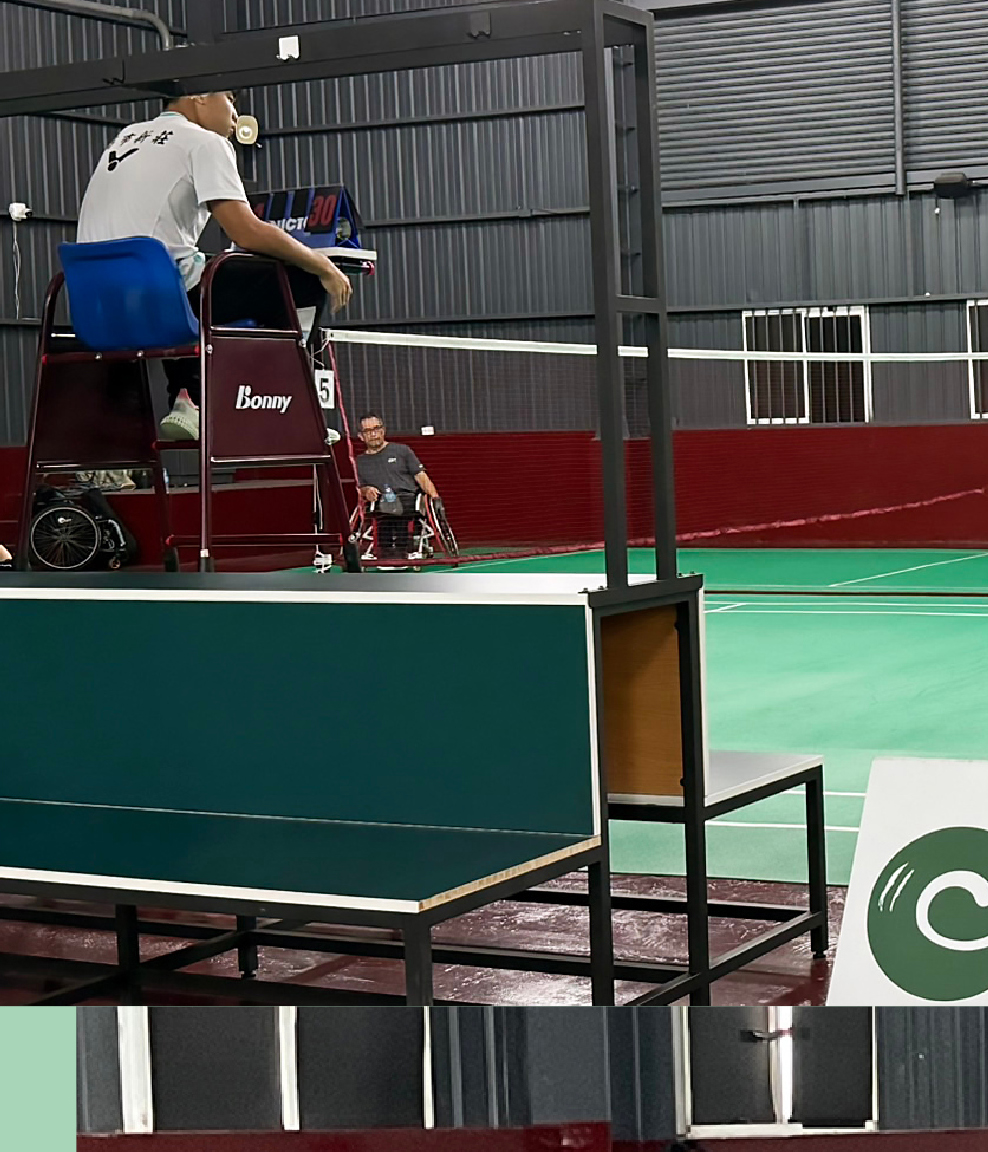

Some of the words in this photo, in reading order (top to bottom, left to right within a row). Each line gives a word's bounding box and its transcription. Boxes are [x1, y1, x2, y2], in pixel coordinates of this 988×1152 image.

[309, 194, 338, 227] 30
[235, 385, 293, 414] Bonny
[319, 377, 330, 403] 5
